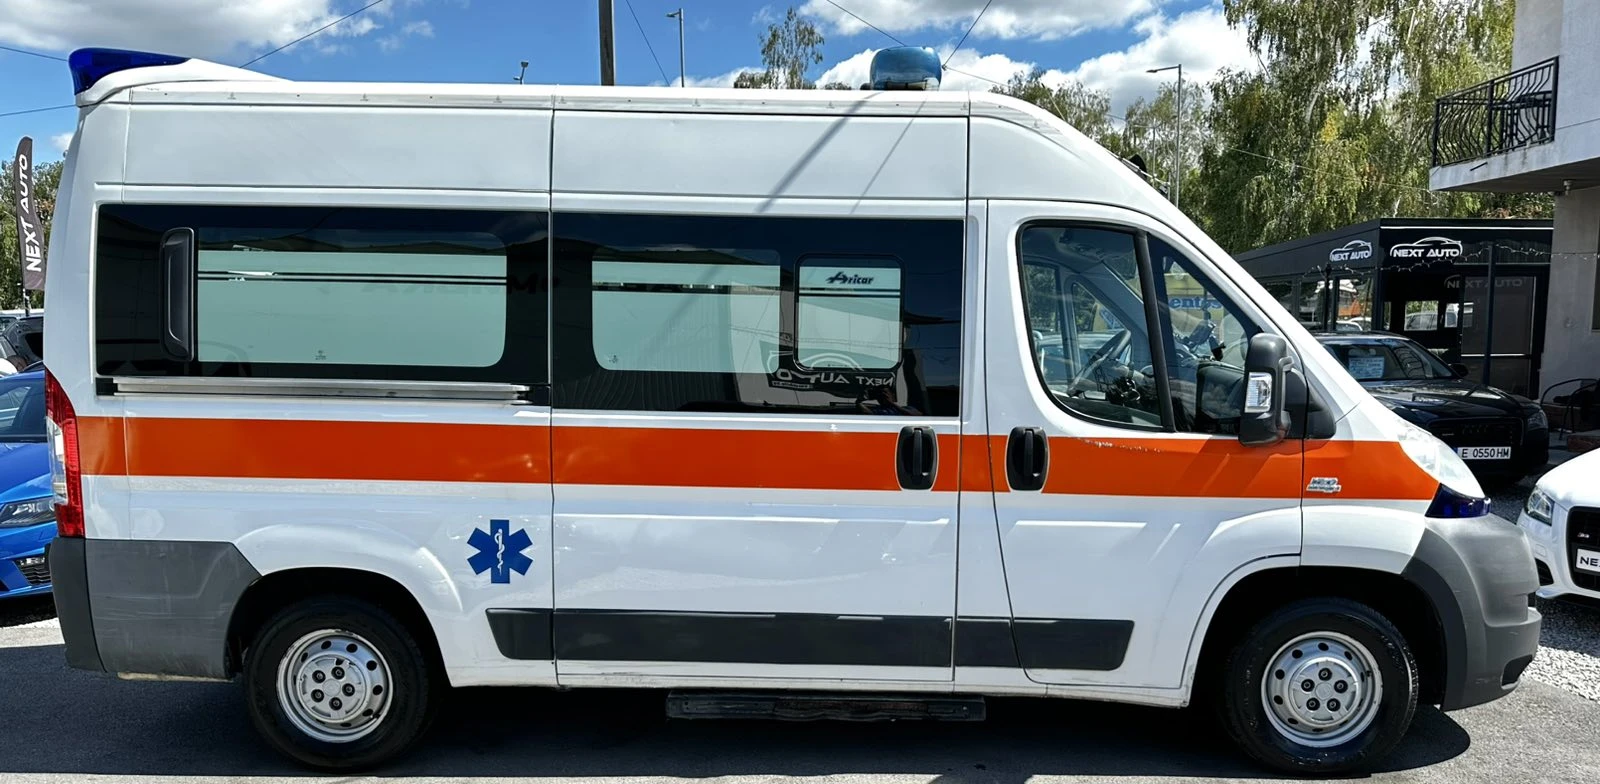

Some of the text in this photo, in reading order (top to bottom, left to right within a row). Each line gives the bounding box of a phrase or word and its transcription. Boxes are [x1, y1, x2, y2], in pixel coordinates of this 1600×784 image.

[18, 154, 42, 272] NEXT AUTO
[1331, 250, 1371, 262] NEXT AUTO
[1393, 248, 1460, 258] NEXT AUTO
[826, 271, 874, 285] Aricar
[1485, 279, 1522, 288] UTO
[1461, 448, 1510, 458] E 0550 HM
[1579, 556, 1600, 568] NE
